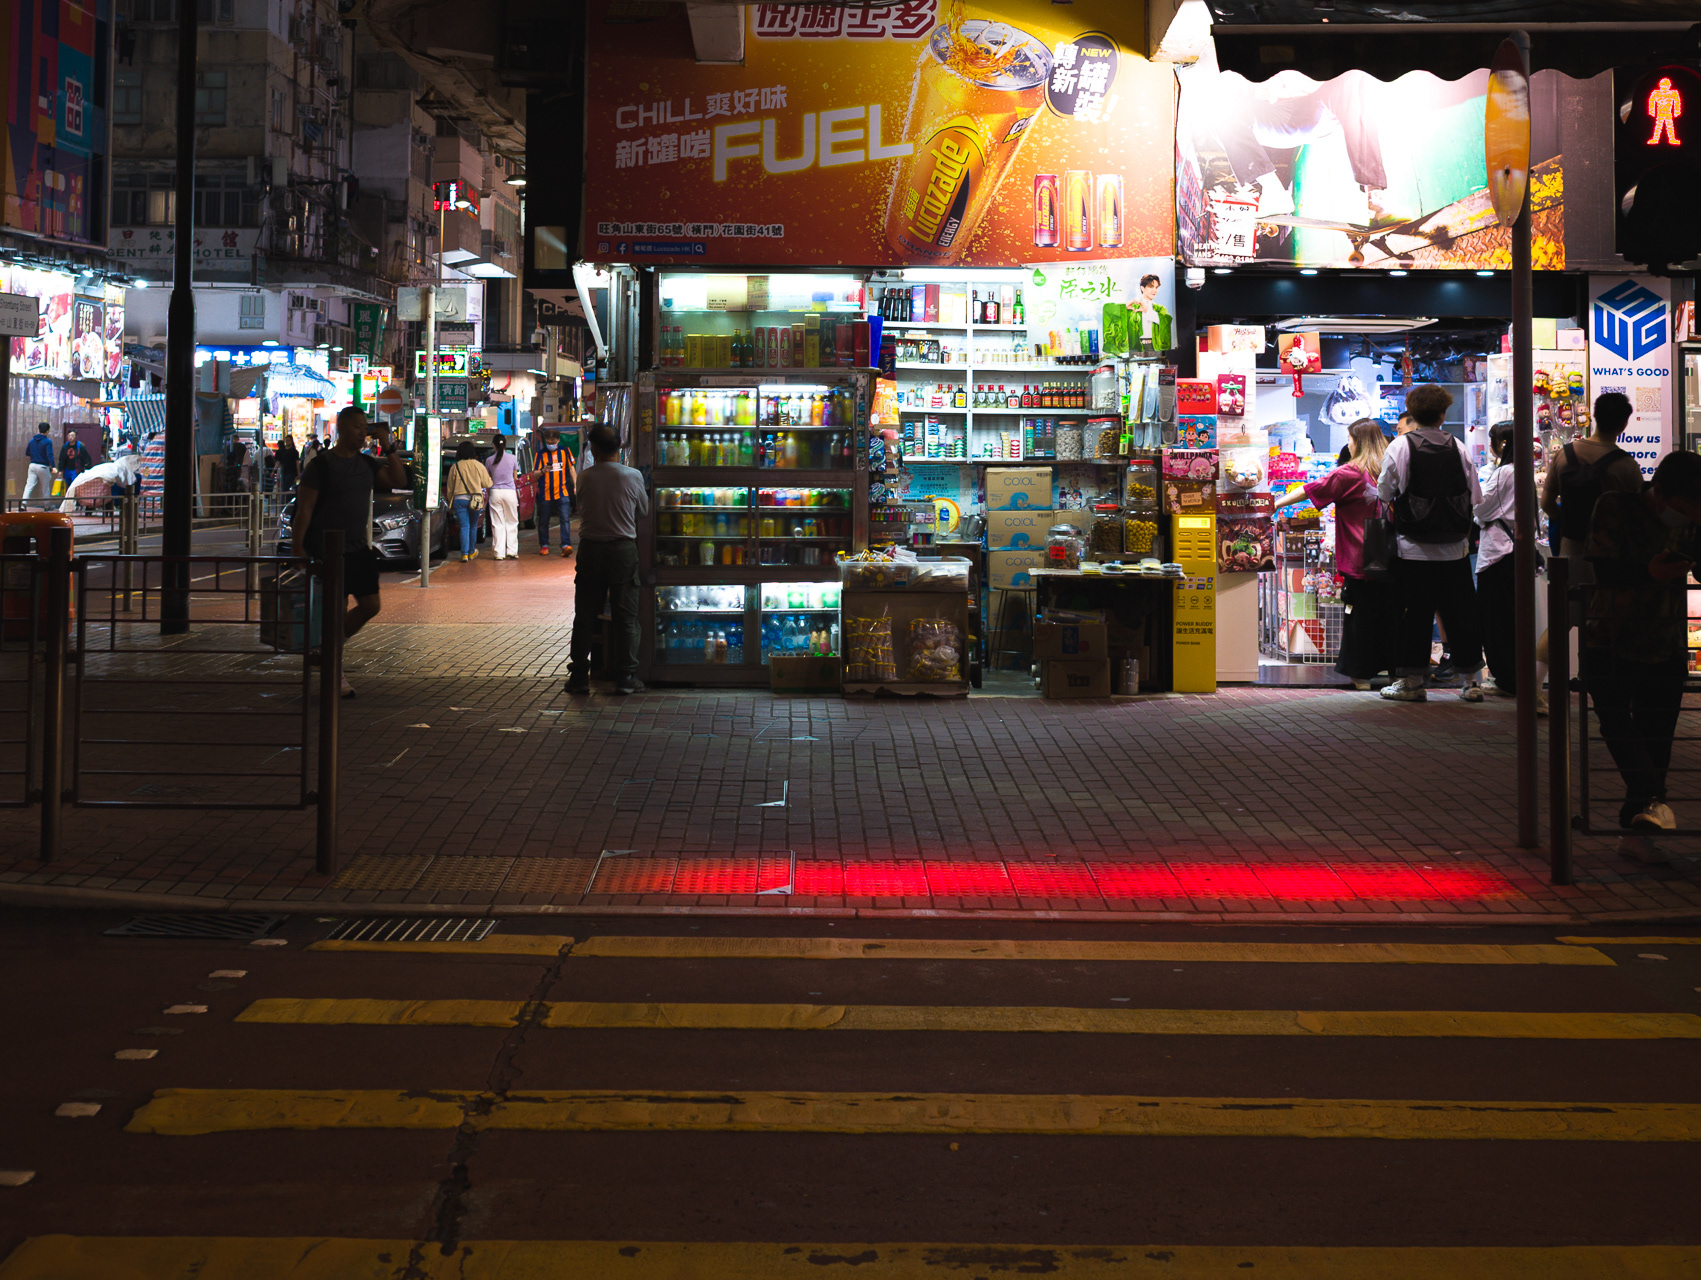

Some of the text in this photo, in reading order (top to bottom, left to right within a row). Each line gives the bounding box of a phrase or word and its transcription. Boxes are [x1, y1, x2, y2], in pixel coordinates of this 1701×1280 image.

[1080, 48, 1112, 58] NEW
[616, 98, 703, 129] CHILL
[704, 84, 787, 118] 爽好味
[712, 105, 913, 182] FUEL
[907, 137, 970, 244] Lucozade
[937, 216, 961, 248] ENERGY
[193, 248, 245, 258] HOTEL
[898, 235, 952, 257] ORANGE
[1593, 368, 1670, 377] WHAT'S GOOD
[1617, 432, 1661, 443] llow us
